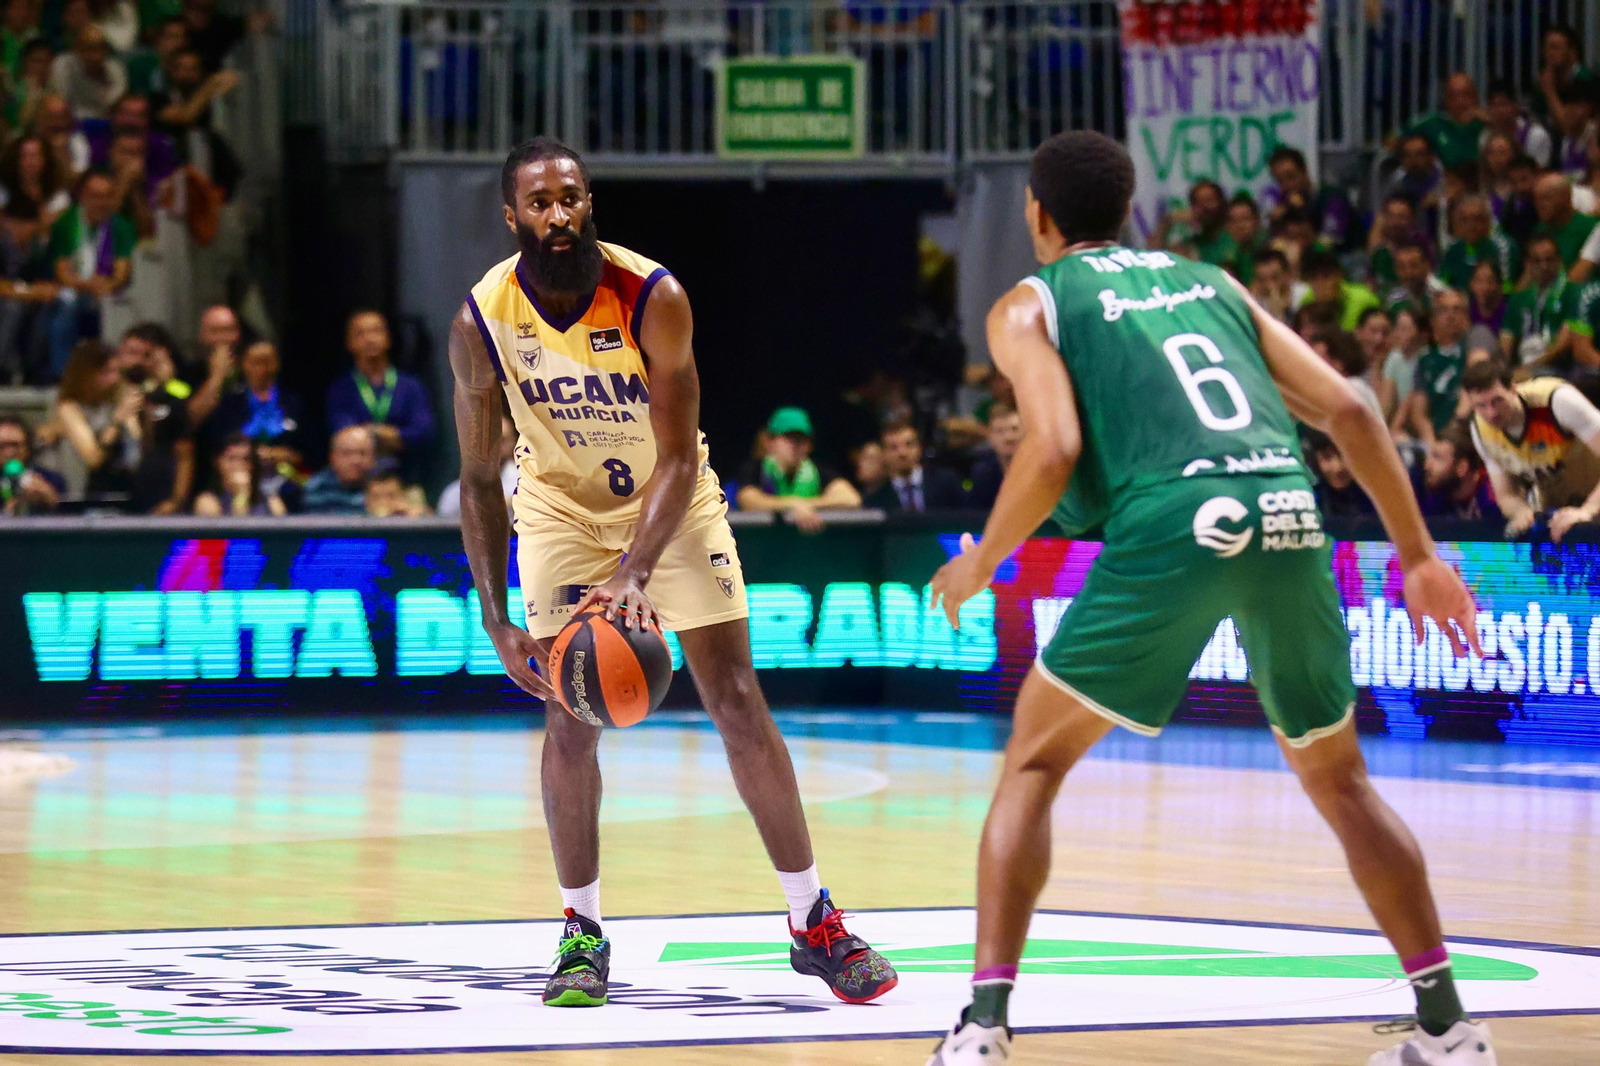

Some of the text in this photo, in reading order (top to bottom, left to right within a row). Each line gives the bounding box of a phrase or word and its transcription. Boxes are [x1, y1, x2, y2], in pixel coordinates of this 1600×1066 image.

[519, 372, 650, 407] UCAM
[1162, 332, 1253, 432] 6
[549, 405, 638, 424] MURCIA
[602, 457, 635, 498] 8
[712, 557, 727, 566] acb
[22, 588, 379, 682] VENTA
[571, 650, 591, 712] endesa
